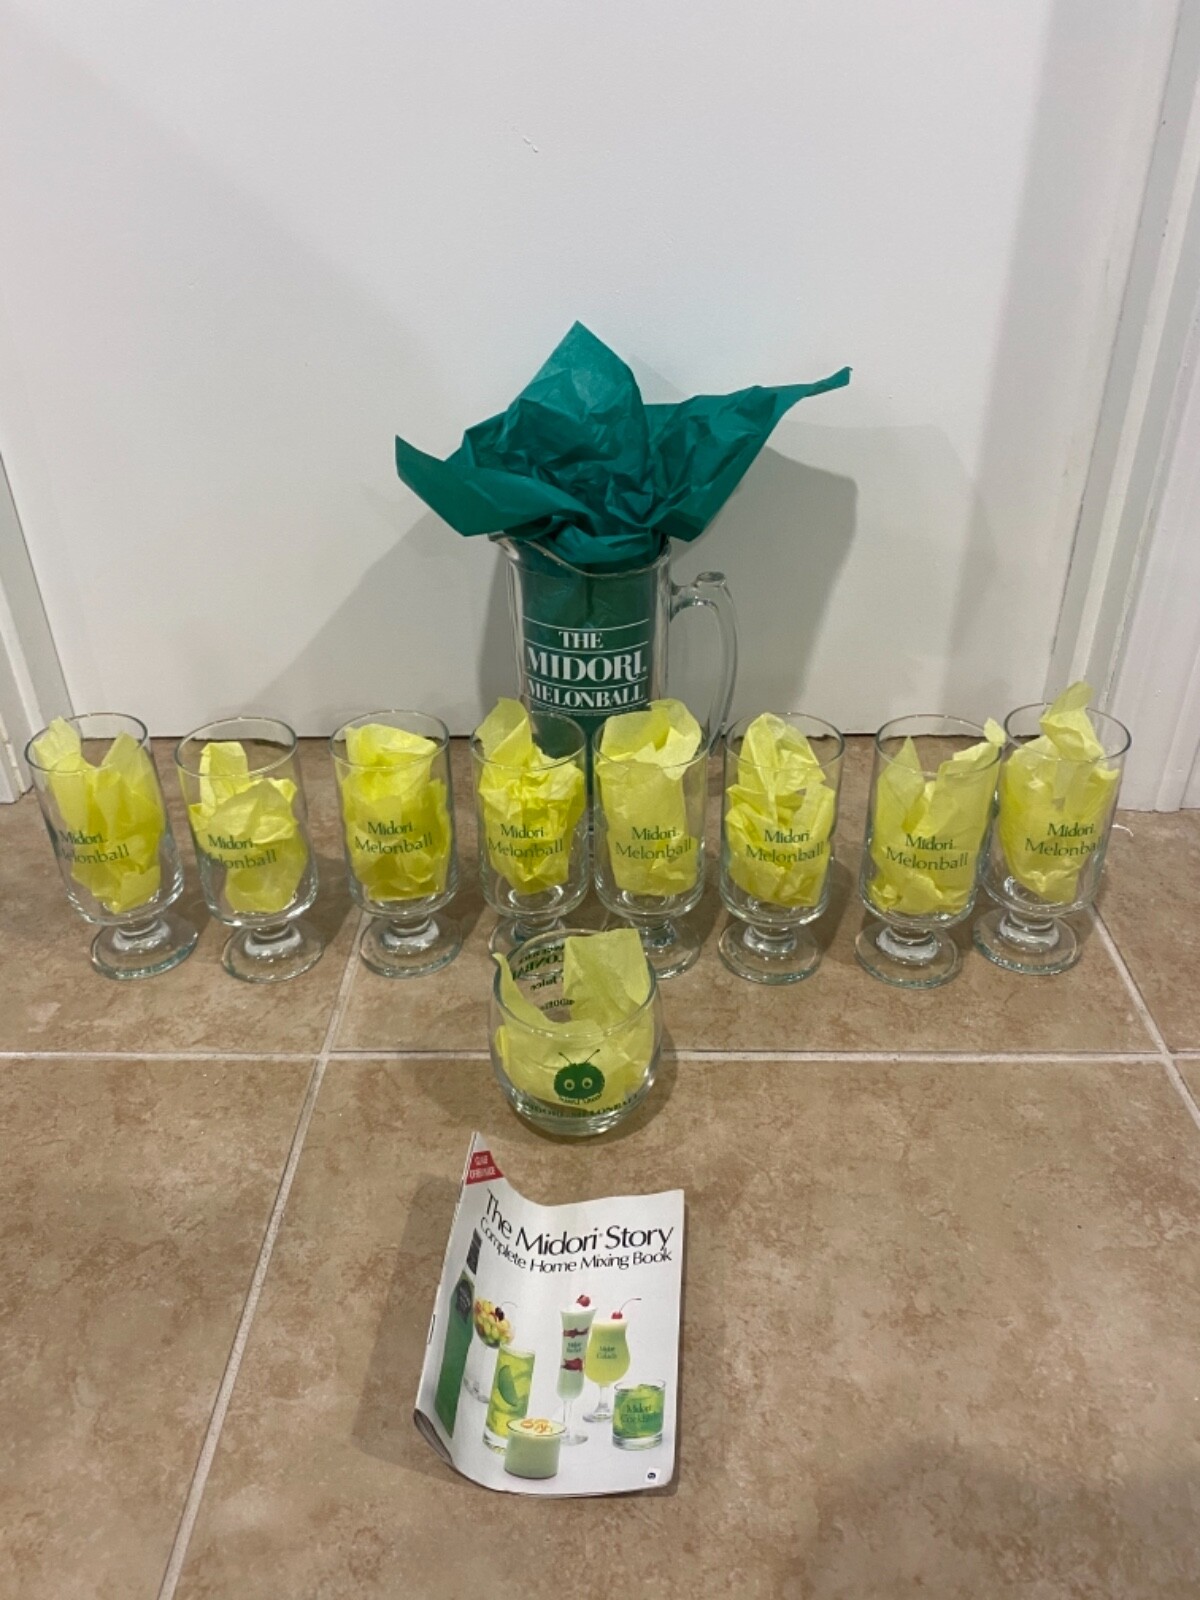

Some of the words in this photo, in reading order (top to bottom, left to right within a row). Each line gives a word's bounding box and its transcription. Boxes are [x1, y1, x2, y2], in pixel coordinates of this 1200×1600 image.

[558, 631, 604, 649] THE
[528, 647, 643, 682] MIDORI
[528, 679, 644, 708] MELONBALL
[367, 820, 413, 836] Midori
[500, 824, 545, 839] Midori
[631, 826, 677, 840] Midori
[764, 828, 810, 844] Midori
[1047, 822, 1094, 837] Midori
[207, 834, 253, 850] Midori
[354, 832, 433, 855] Melonball
[488, 838, 564, 858] Melonball
[615, 837, 692, 860] Melonball
[746, 840, 826, 863] Melonball
[905, 832, 954, 851] Midori
[886, 846, 968, 871] Melonball
[486, 1188, 513, 1240] The
[515, 1226, 599, 1256] Midori
[604, 1224, 675, 1252] Story
[480, 1216, 527, 1269] Complete
[529, 1259, 577, 1273] Home
[580, 1254, 630, 1271] Mixing
[632, 1248, 673, 1266] Book
